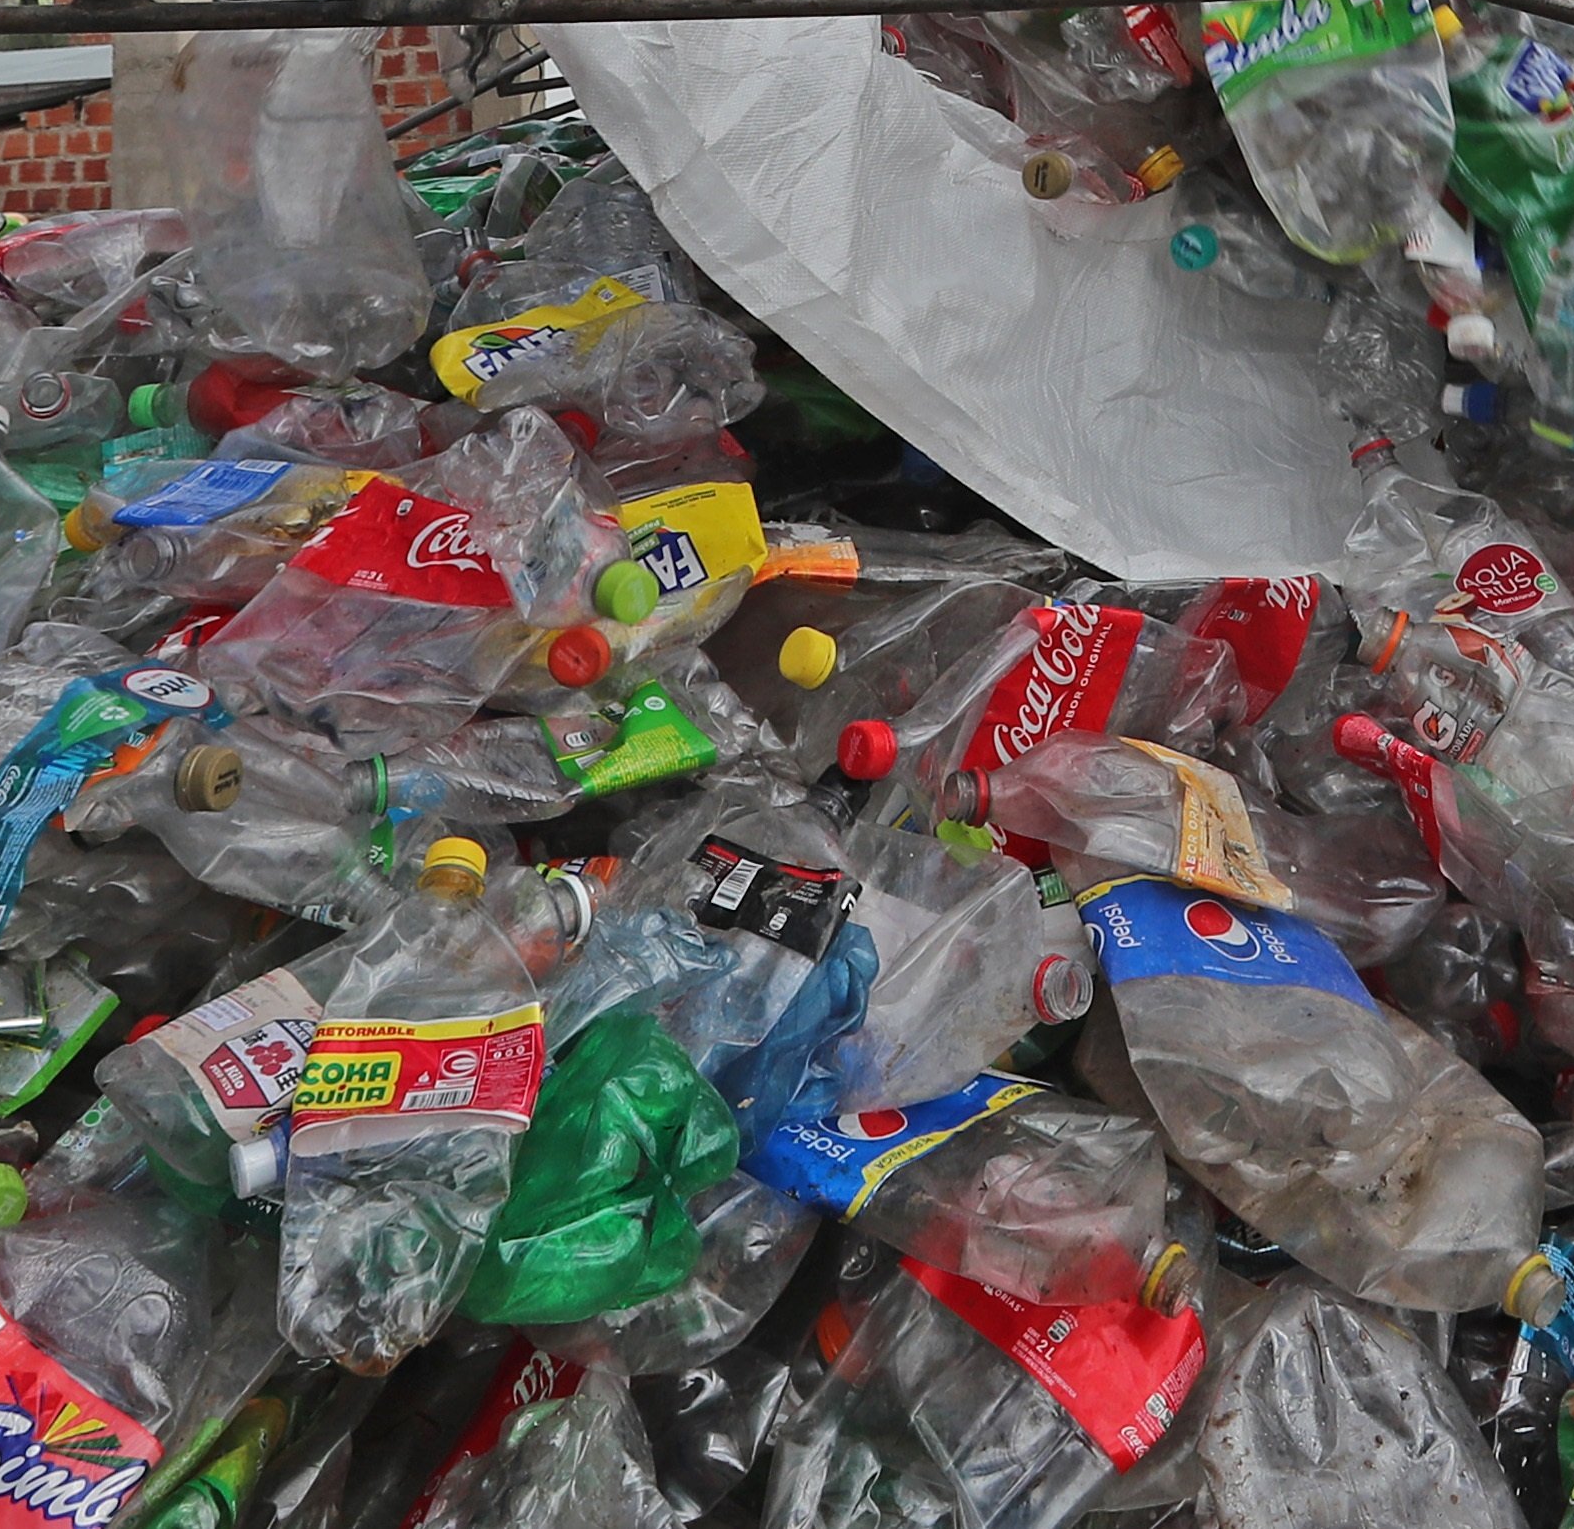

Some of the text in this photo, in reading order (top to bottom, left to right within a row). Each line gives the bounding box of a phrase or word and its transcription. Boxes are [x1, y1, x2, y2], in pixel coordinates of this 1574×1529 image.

[1461, 550, 1529, 589] AQUA
[1061, 621, 1114, 730] ABOR ORIGINAL
[1097, 902, 1143, 950] pepsi
[1250, 920, 1298, 964] pepsi
[315, 1024, 417, 1039] RETORNABLE
[223, 1064, 245, 1090] Kilo
[301, 1058, 392, 1086] COKA
[780, 1122, 857, 1166] pepsi
